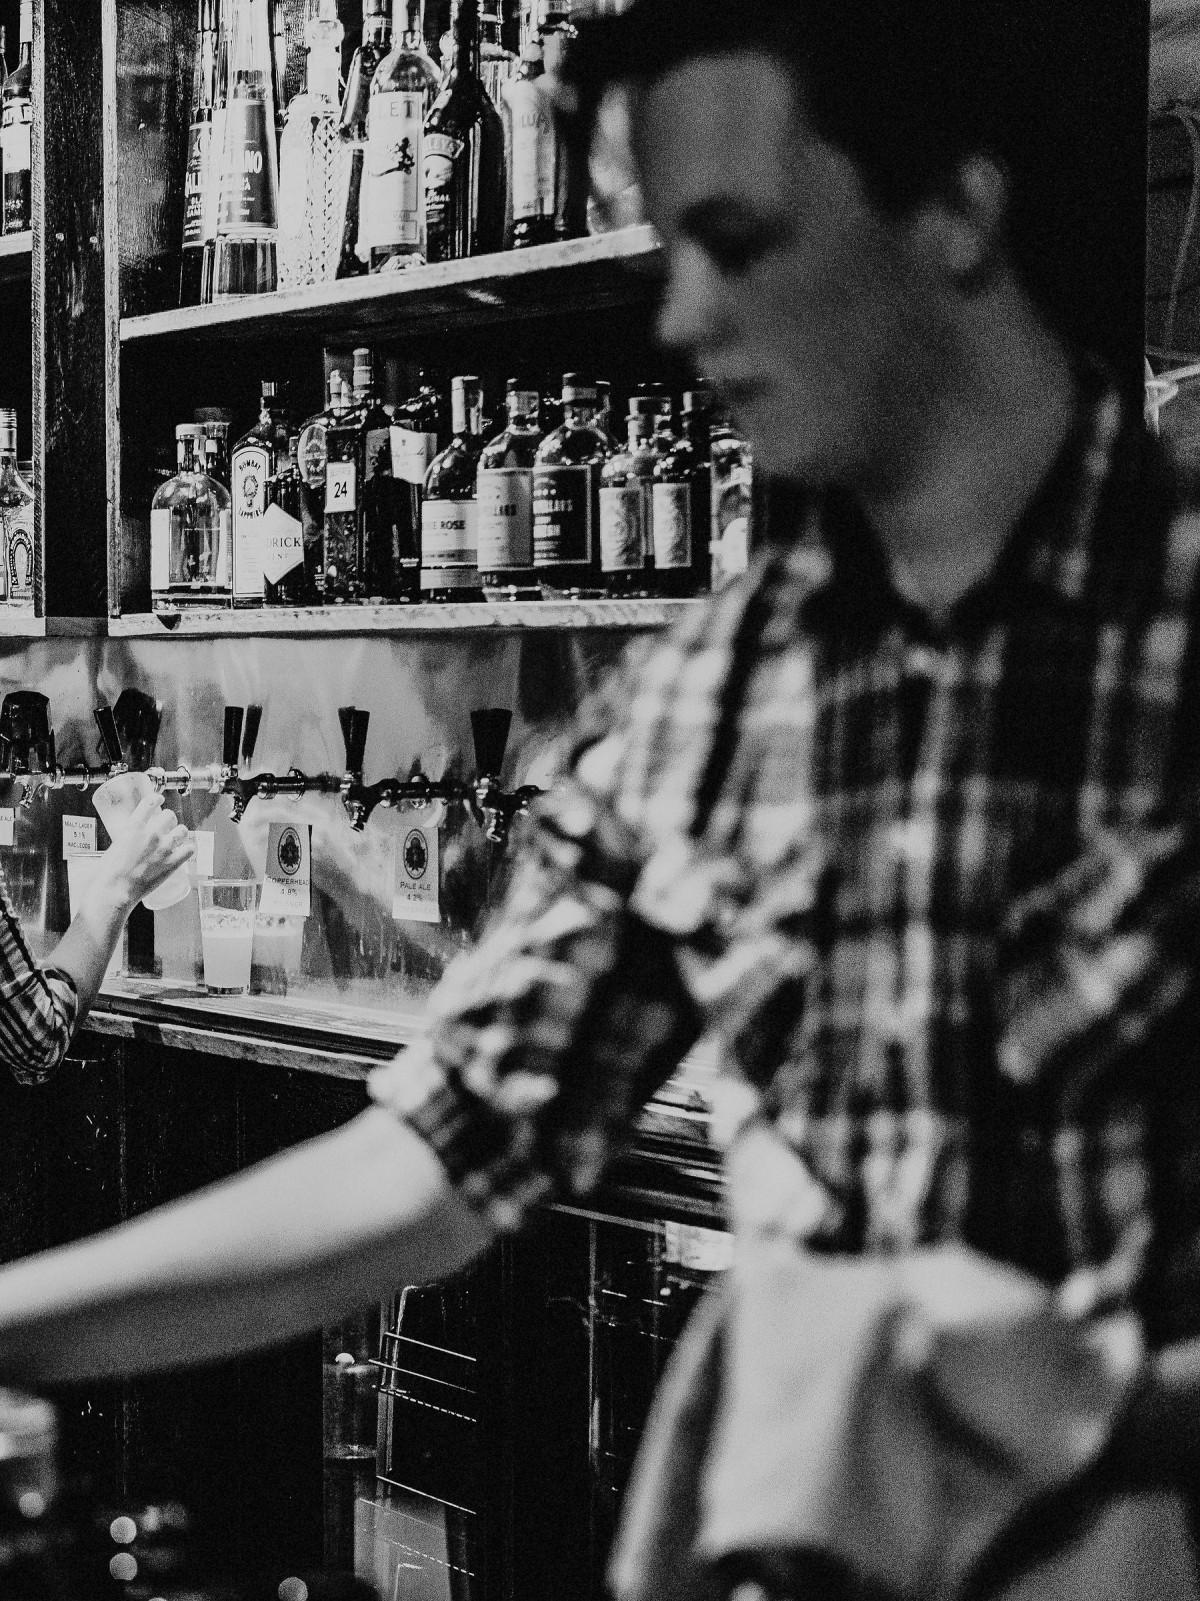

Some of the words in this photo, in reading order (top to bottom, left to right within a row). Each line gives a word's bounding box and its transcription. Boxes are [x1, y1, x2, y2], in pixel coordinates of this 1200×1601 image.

[238, 459, 261, 474] BOMBAY
[333, 480, 348, 499] 24
[399, 881, 417, 890] PALE
[418, 883, 432, 891] ALE
